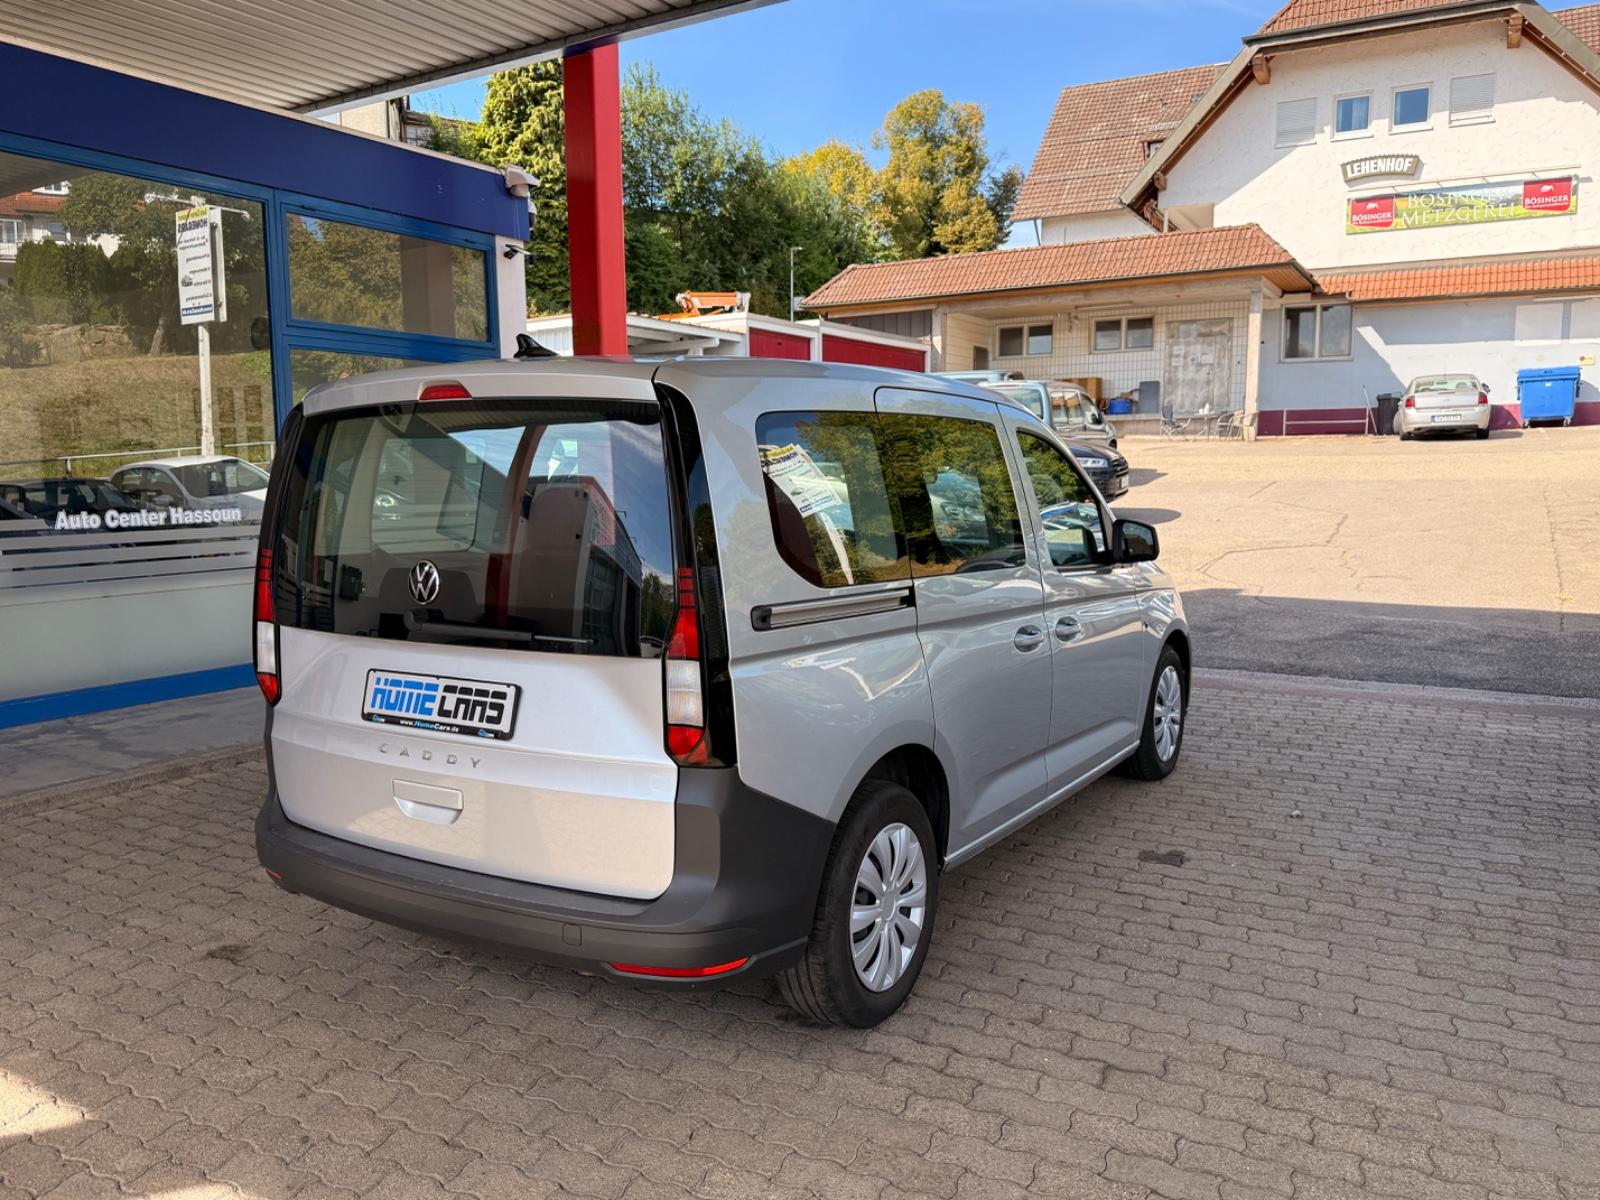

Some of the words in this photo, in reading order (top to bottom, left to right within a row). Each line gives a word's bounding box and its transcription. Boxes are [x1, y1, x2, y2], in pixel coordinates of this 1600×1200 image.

[1346, 157, 1413, 178] LEHENHOF
[1401, 203, 1515, 226] METZGEREI
[55, 508, 101, 530] Auto
[104, 508, 167, 528] Center
[169, 506, 242, 524] Hassoun
[378, 743, 481, 768] CADDY
